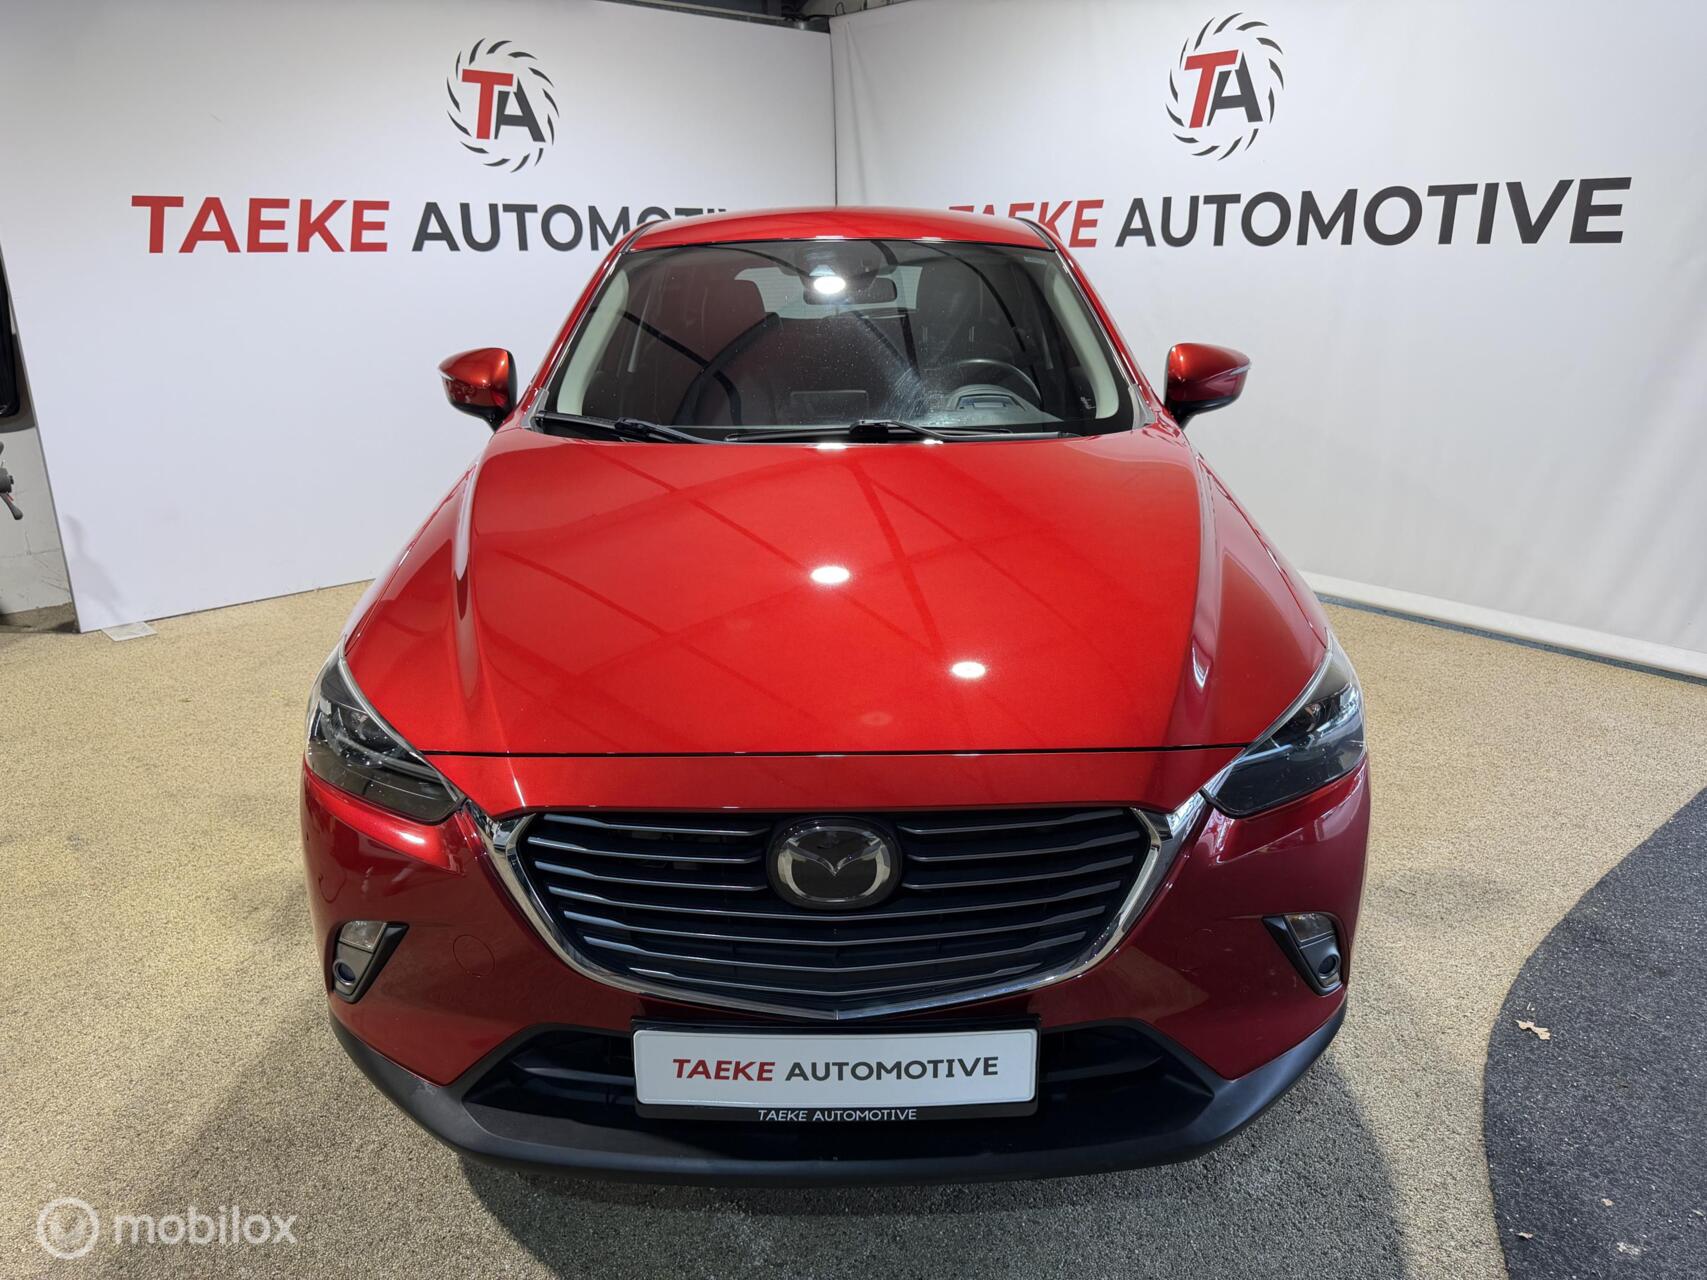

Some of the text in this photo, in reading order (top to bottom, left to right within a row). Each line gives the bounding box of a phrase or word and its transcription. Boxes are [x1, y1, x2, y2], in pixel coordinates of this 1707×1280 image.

[461, 68, 546, 143] TA
[1184, 49, 1264, 129] TA
[131, 195, 389, 254] TAEKE
[1115, 176, 1632, 247] AUTOMOTIVE
[672, 1056, 999, 1082] TAEKE AUTOMOTIVE
[758, 1108, 917, 1122] TAEKE AUTOMOTIVE
